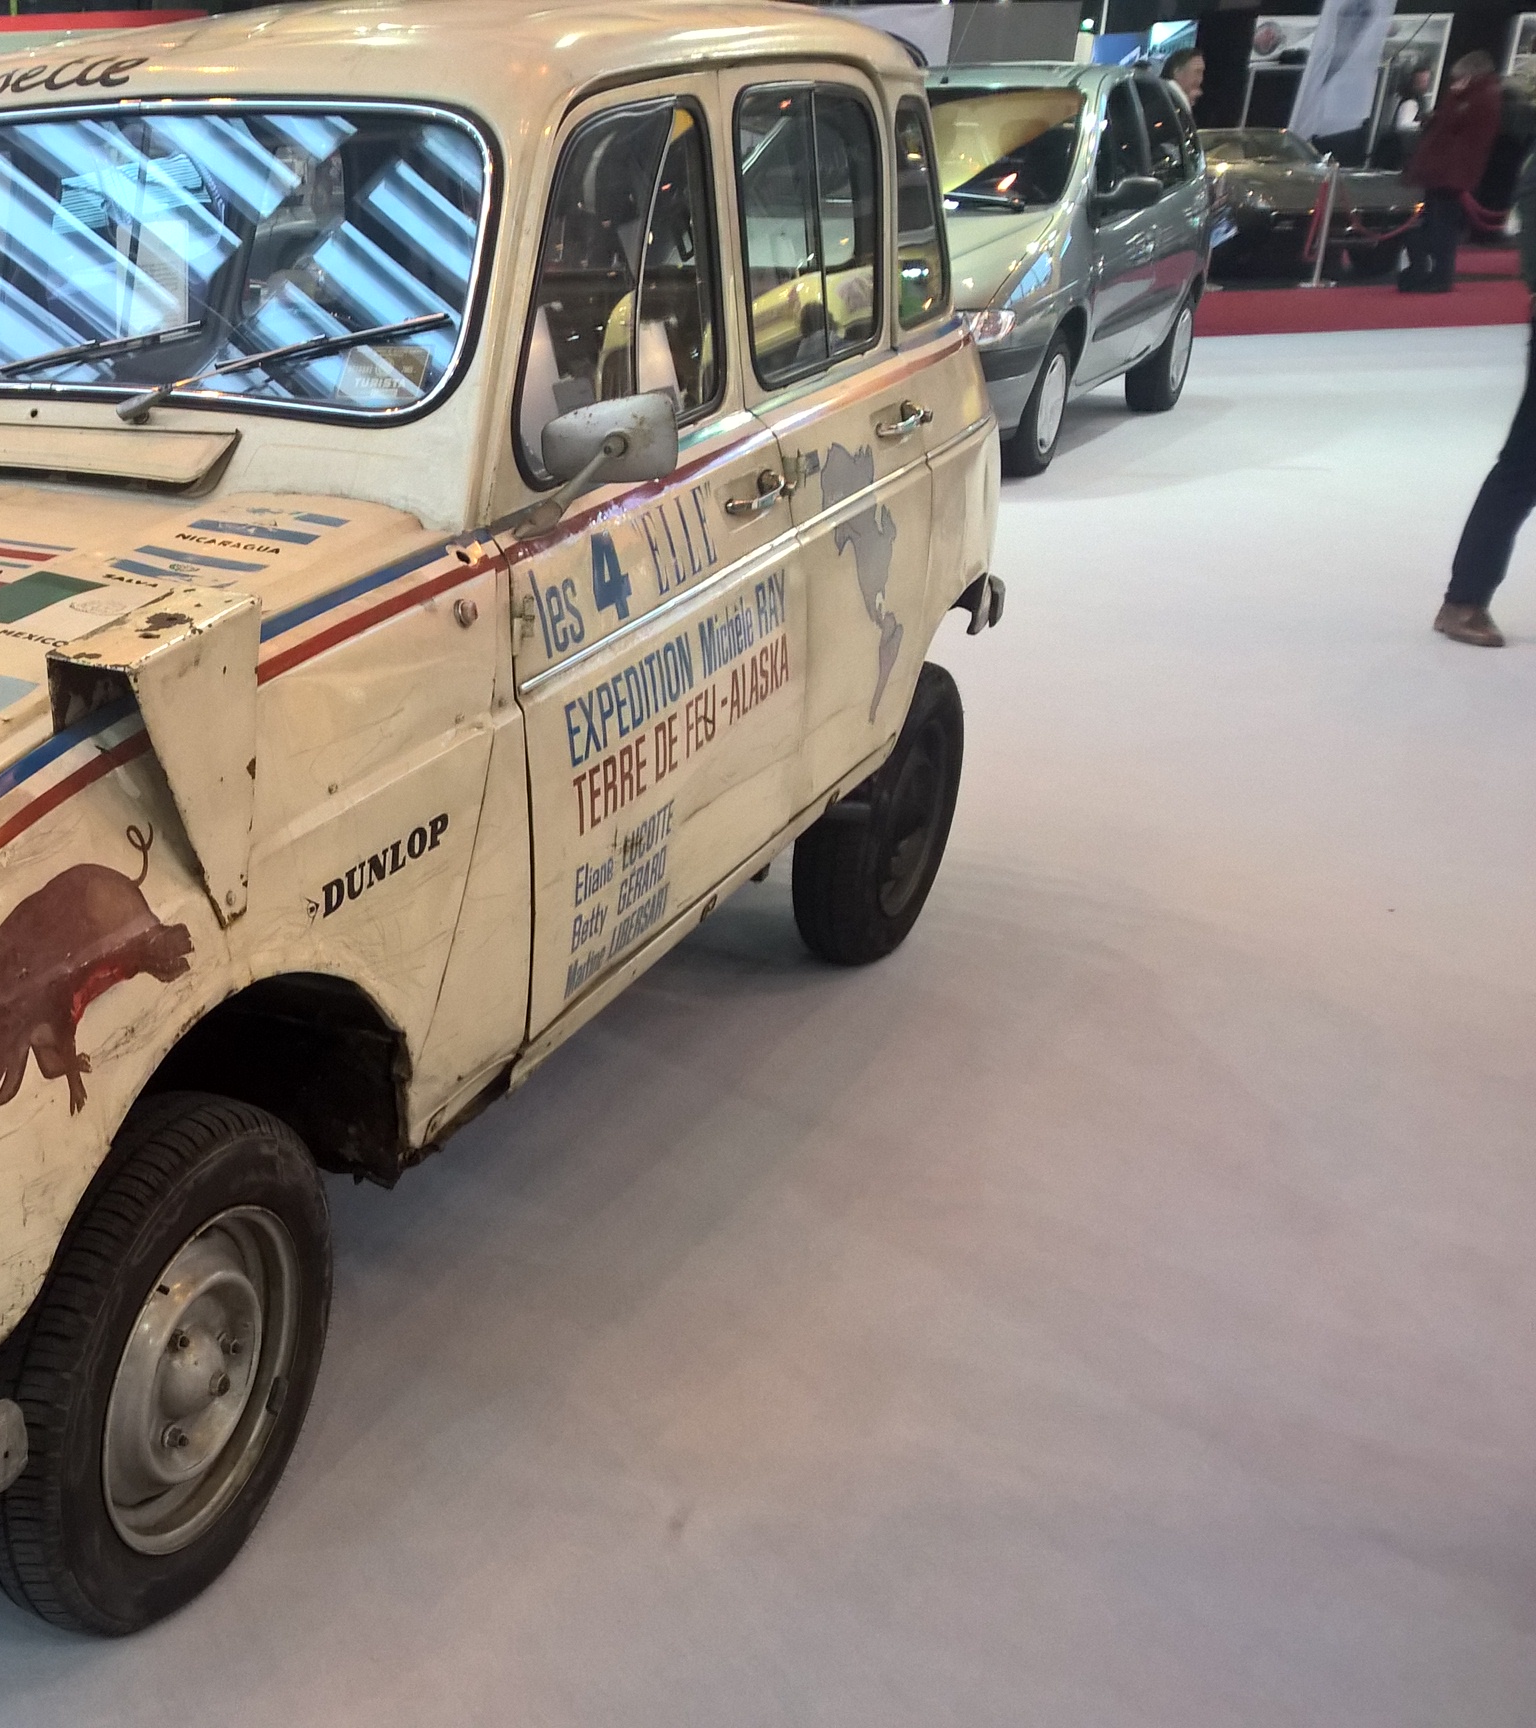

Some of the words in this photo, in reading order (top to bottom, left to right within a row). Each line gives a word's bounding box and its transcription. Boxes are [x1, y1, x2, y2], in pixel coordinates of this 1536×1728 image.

[175, 532, 280, 555] NICARAGUA
[528, 569, 585, 659] les
[590, 530, 632, 620] 4
[564, 632, 695, 768] EXPEDITION
[755, 568, 786, 640] RAY
[573, 734, 648, 836] TERRE
[654, 712, 678, 784] DE
[321, 813, 450, 919] DUNLOP
[574, 857, 614, 909] Eliane
[571, 903, 609, 954] Betty
